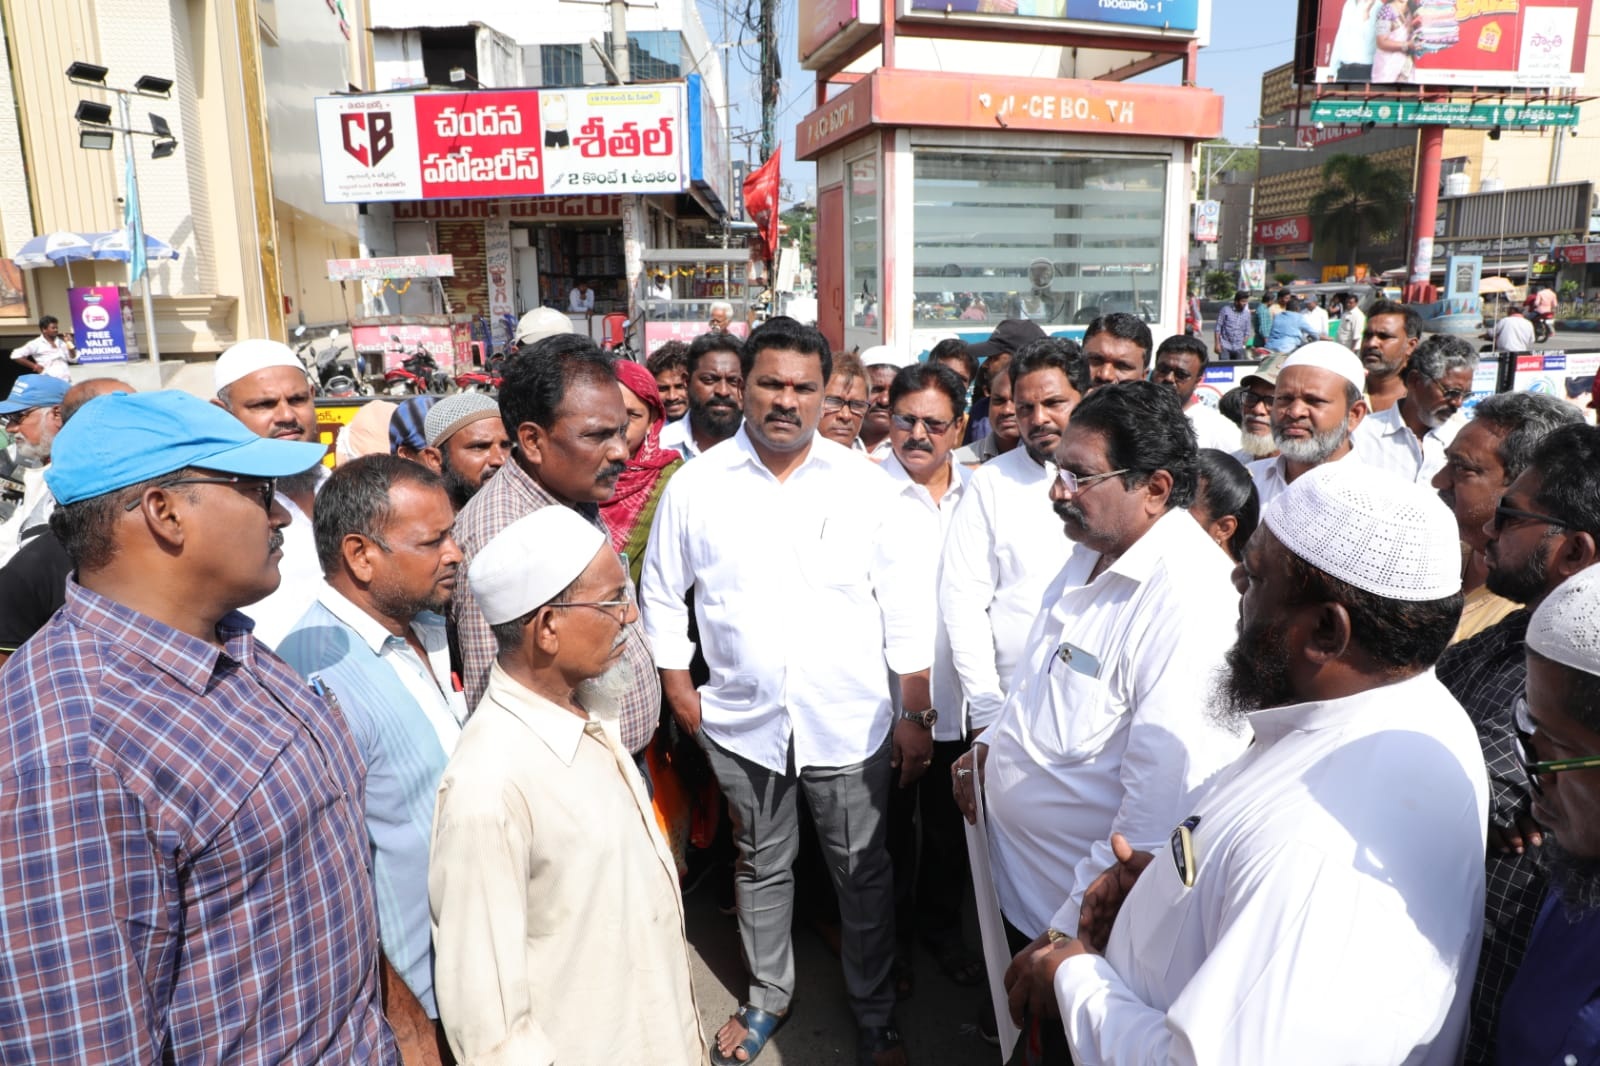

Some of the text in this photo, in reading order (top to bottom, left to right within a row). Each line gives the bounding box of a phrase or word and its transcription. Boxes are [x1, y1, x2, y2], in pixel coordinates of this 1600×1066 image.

[1060, 97, 1134, 123] BOTH
[434, 105, 522, 137] చందన
[340, 112, 394, 168] CB
[572, 117, 674, 158] శీతల్
[568, 173, 579, 185] 2
[621, 173, 627, 184] 1
[631, 169, 677, 184] ఉచితం
[85, 339, 114, 347] VALET
[86, 331, 111, 339] FREE
[80, 347, 122, 355] PARKING
